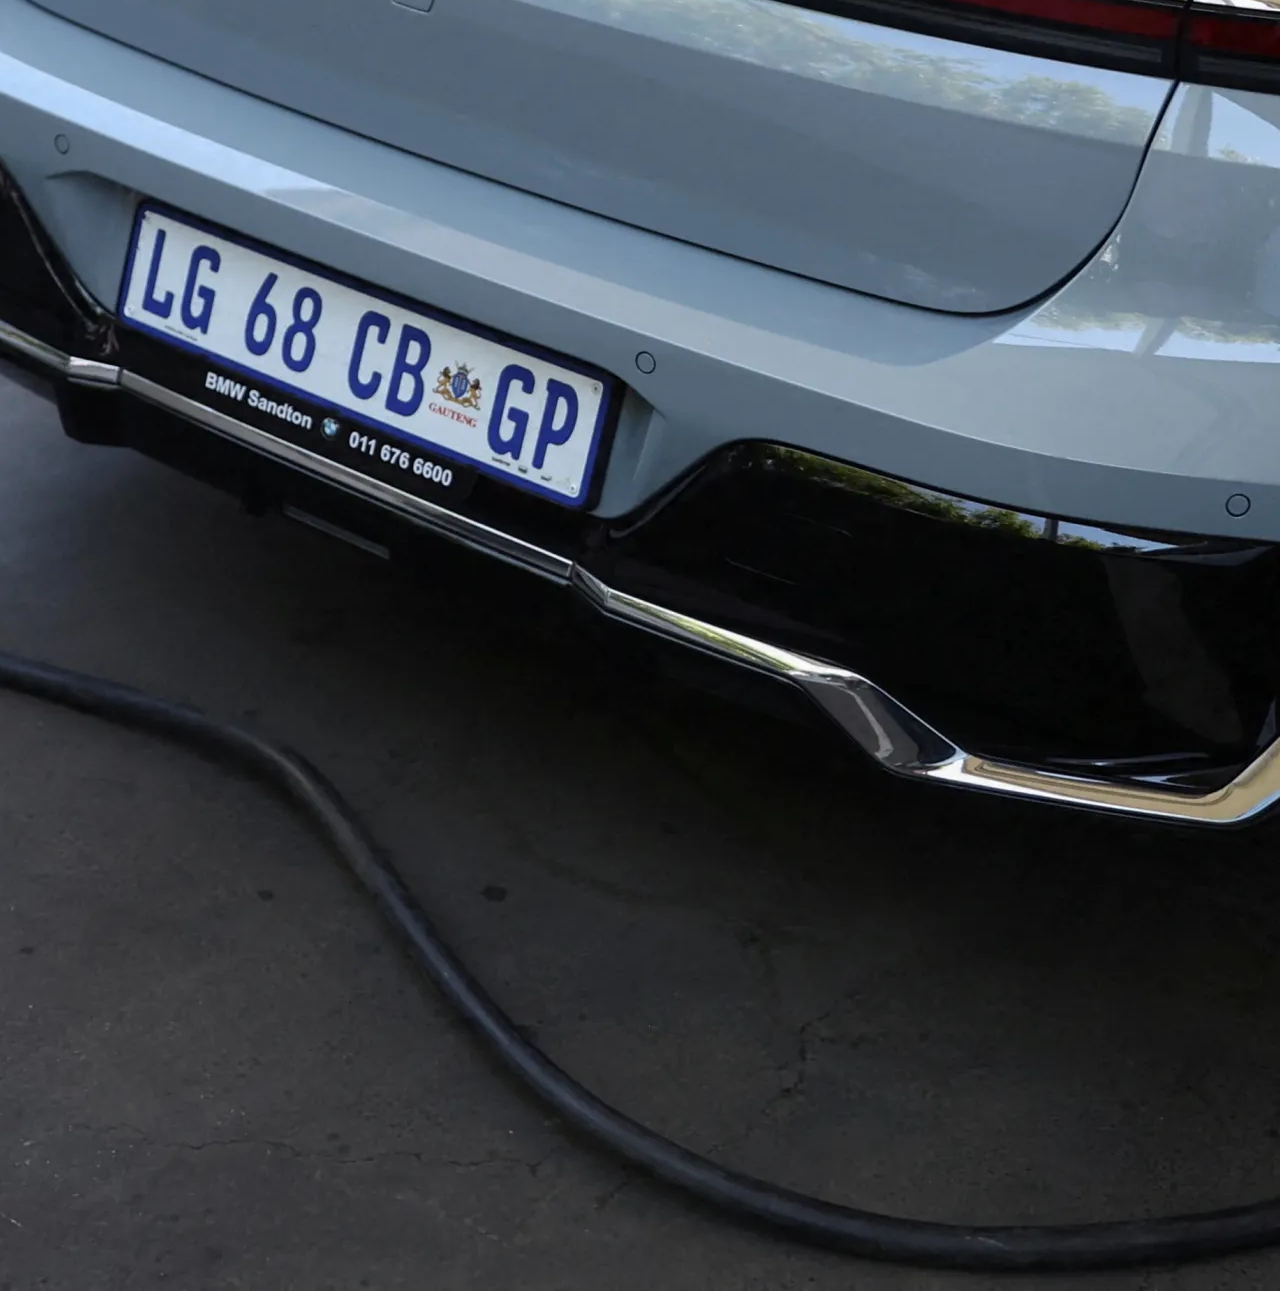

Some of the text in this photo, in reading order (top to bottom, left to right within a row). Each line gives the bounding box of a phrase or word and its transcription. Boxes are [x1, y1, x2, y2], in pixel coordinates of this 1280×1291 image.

[142, 228, 579, 470] LG 68 CB GP
[205, 371, 452, 486] BMW Sandton 011 676 6600
[428, 402, 477, 428] GAUTENG
